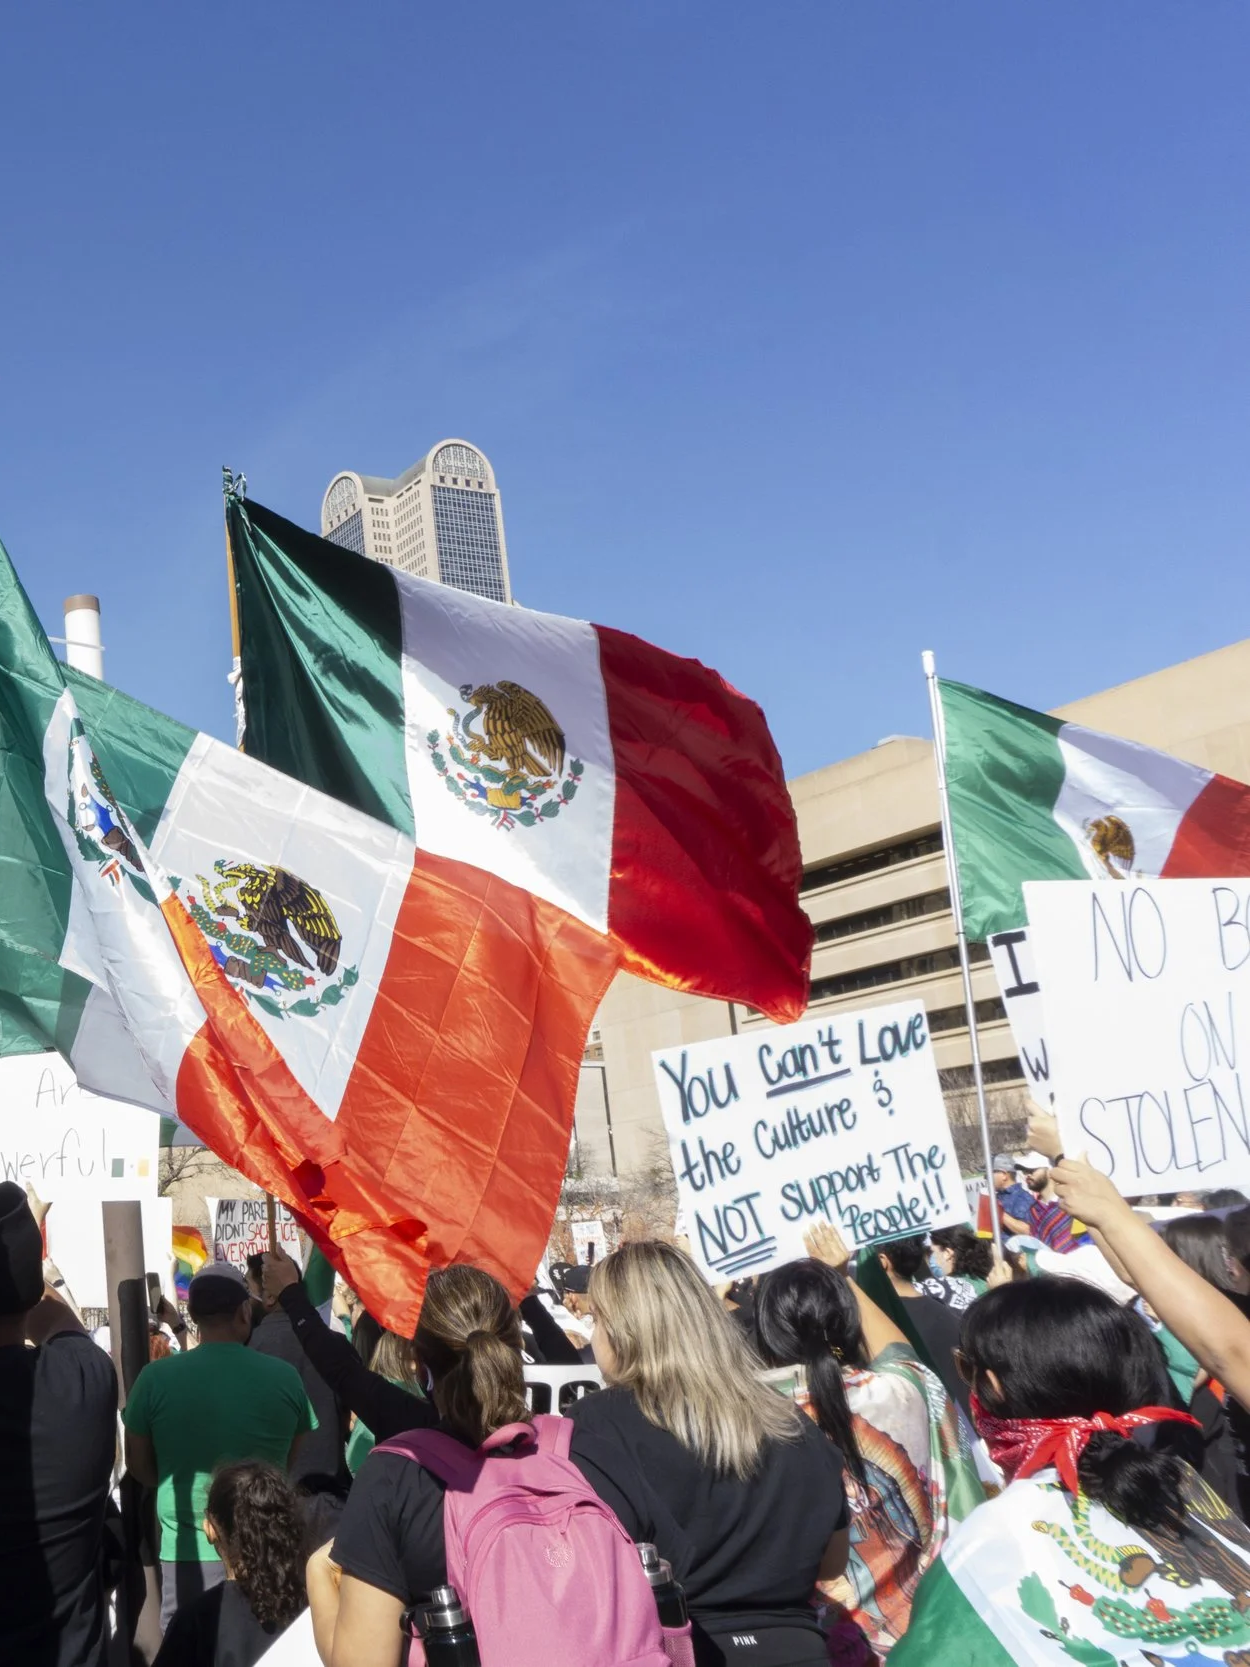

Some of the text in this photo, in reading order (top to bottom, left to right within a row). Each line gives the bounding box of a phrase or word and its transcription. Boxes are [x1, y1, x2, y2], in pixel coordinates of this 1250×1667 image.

[1092, 887, 1250, 983] NO B
[758, 1025, 843, 1086] Can't
[858, 1012, 927, 1066] Love
[1180, 991, 1236, 1082] ON
[679, 1136, 741, 1192] the
[754, 1097, 857, 1160] Culture
[1079, 1072, 1250, 1178] STOLEN
[217, 1200, 293, 1222] MY PARETS
[694, 1191, 765, 1264] NOT
[882, 1141, 947, 1184] The
[732, 1635, 758, 1646] PINK
